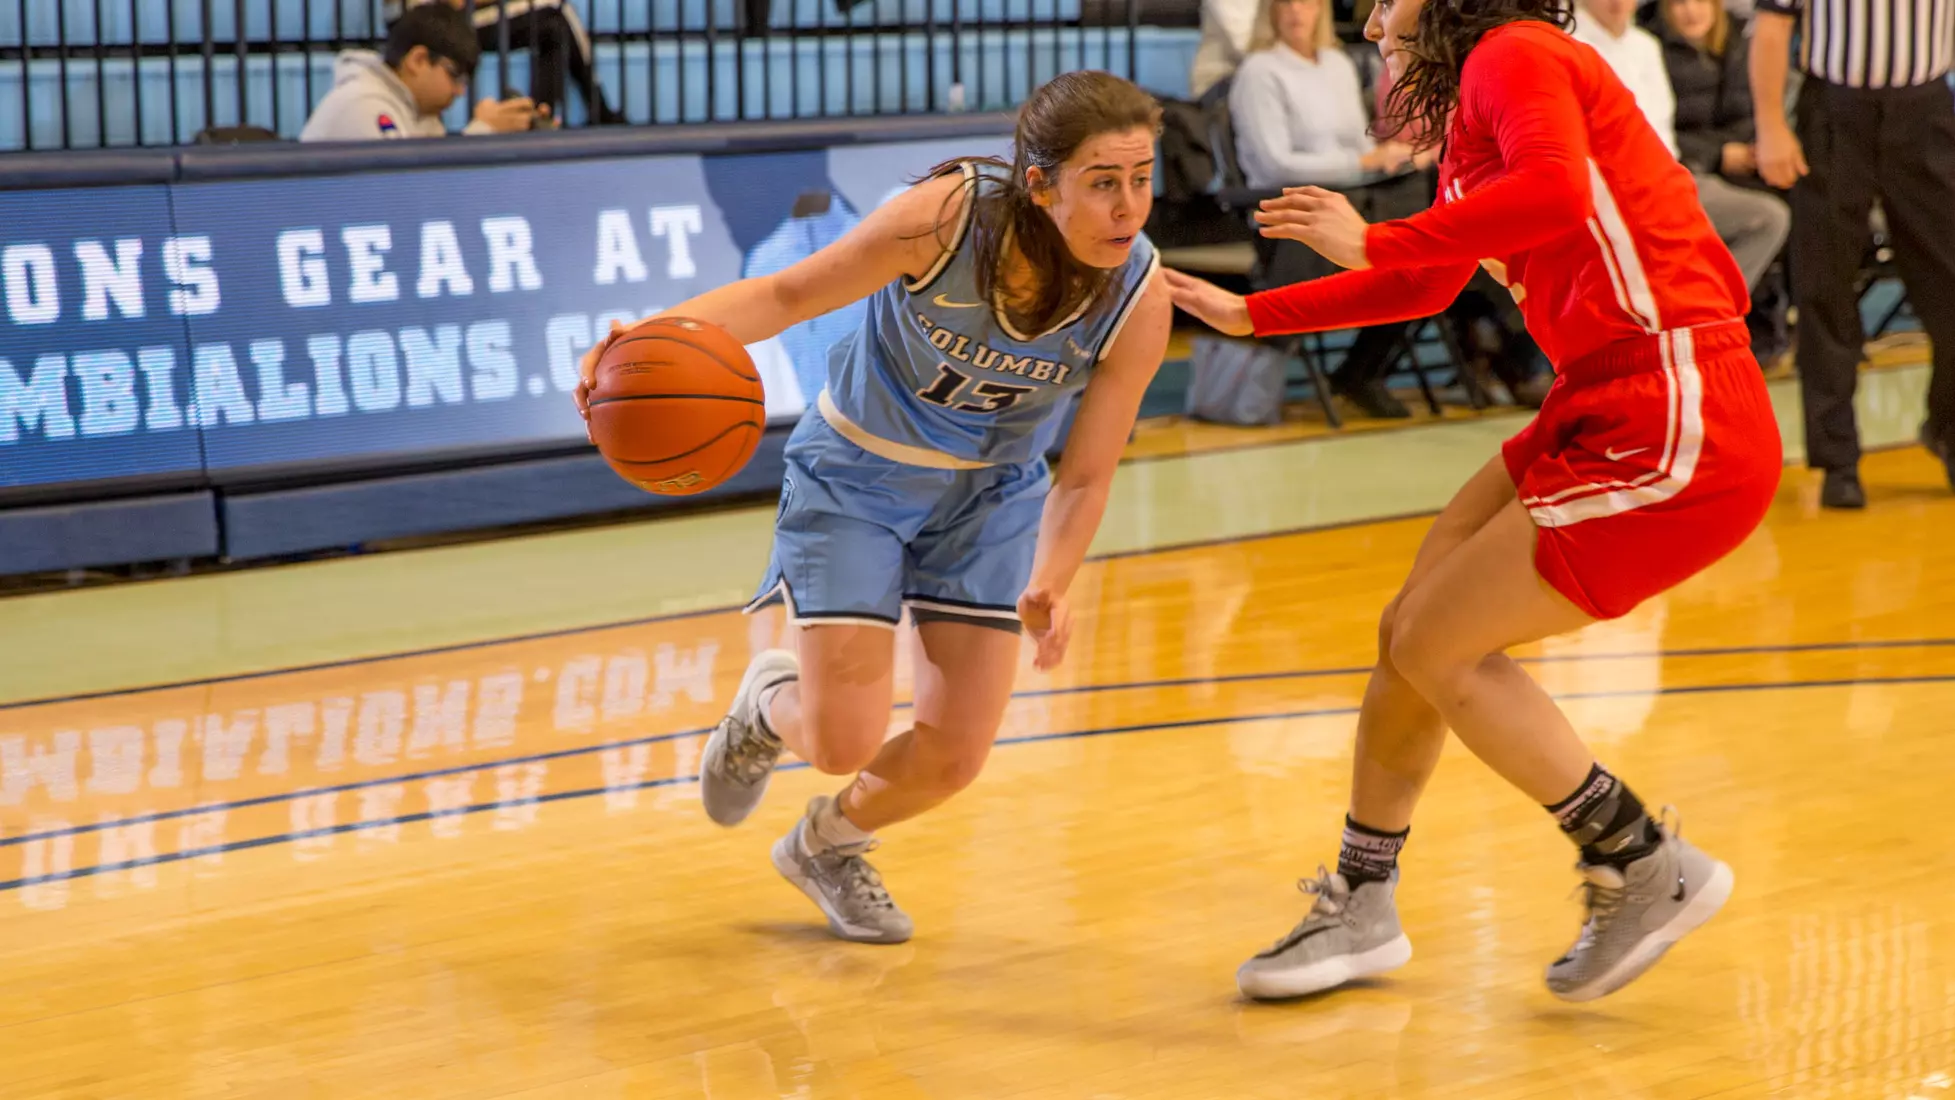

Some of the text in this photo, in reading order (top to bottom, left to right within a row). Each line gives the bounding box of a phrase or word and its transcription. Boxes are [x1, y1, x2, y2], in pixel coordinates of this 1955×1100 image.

[2, 204, 703, 325] ONS GEAR AT
[0, 306, 665, 442] MBIALIONS.C
[916, 361, 1039, 413] 13
